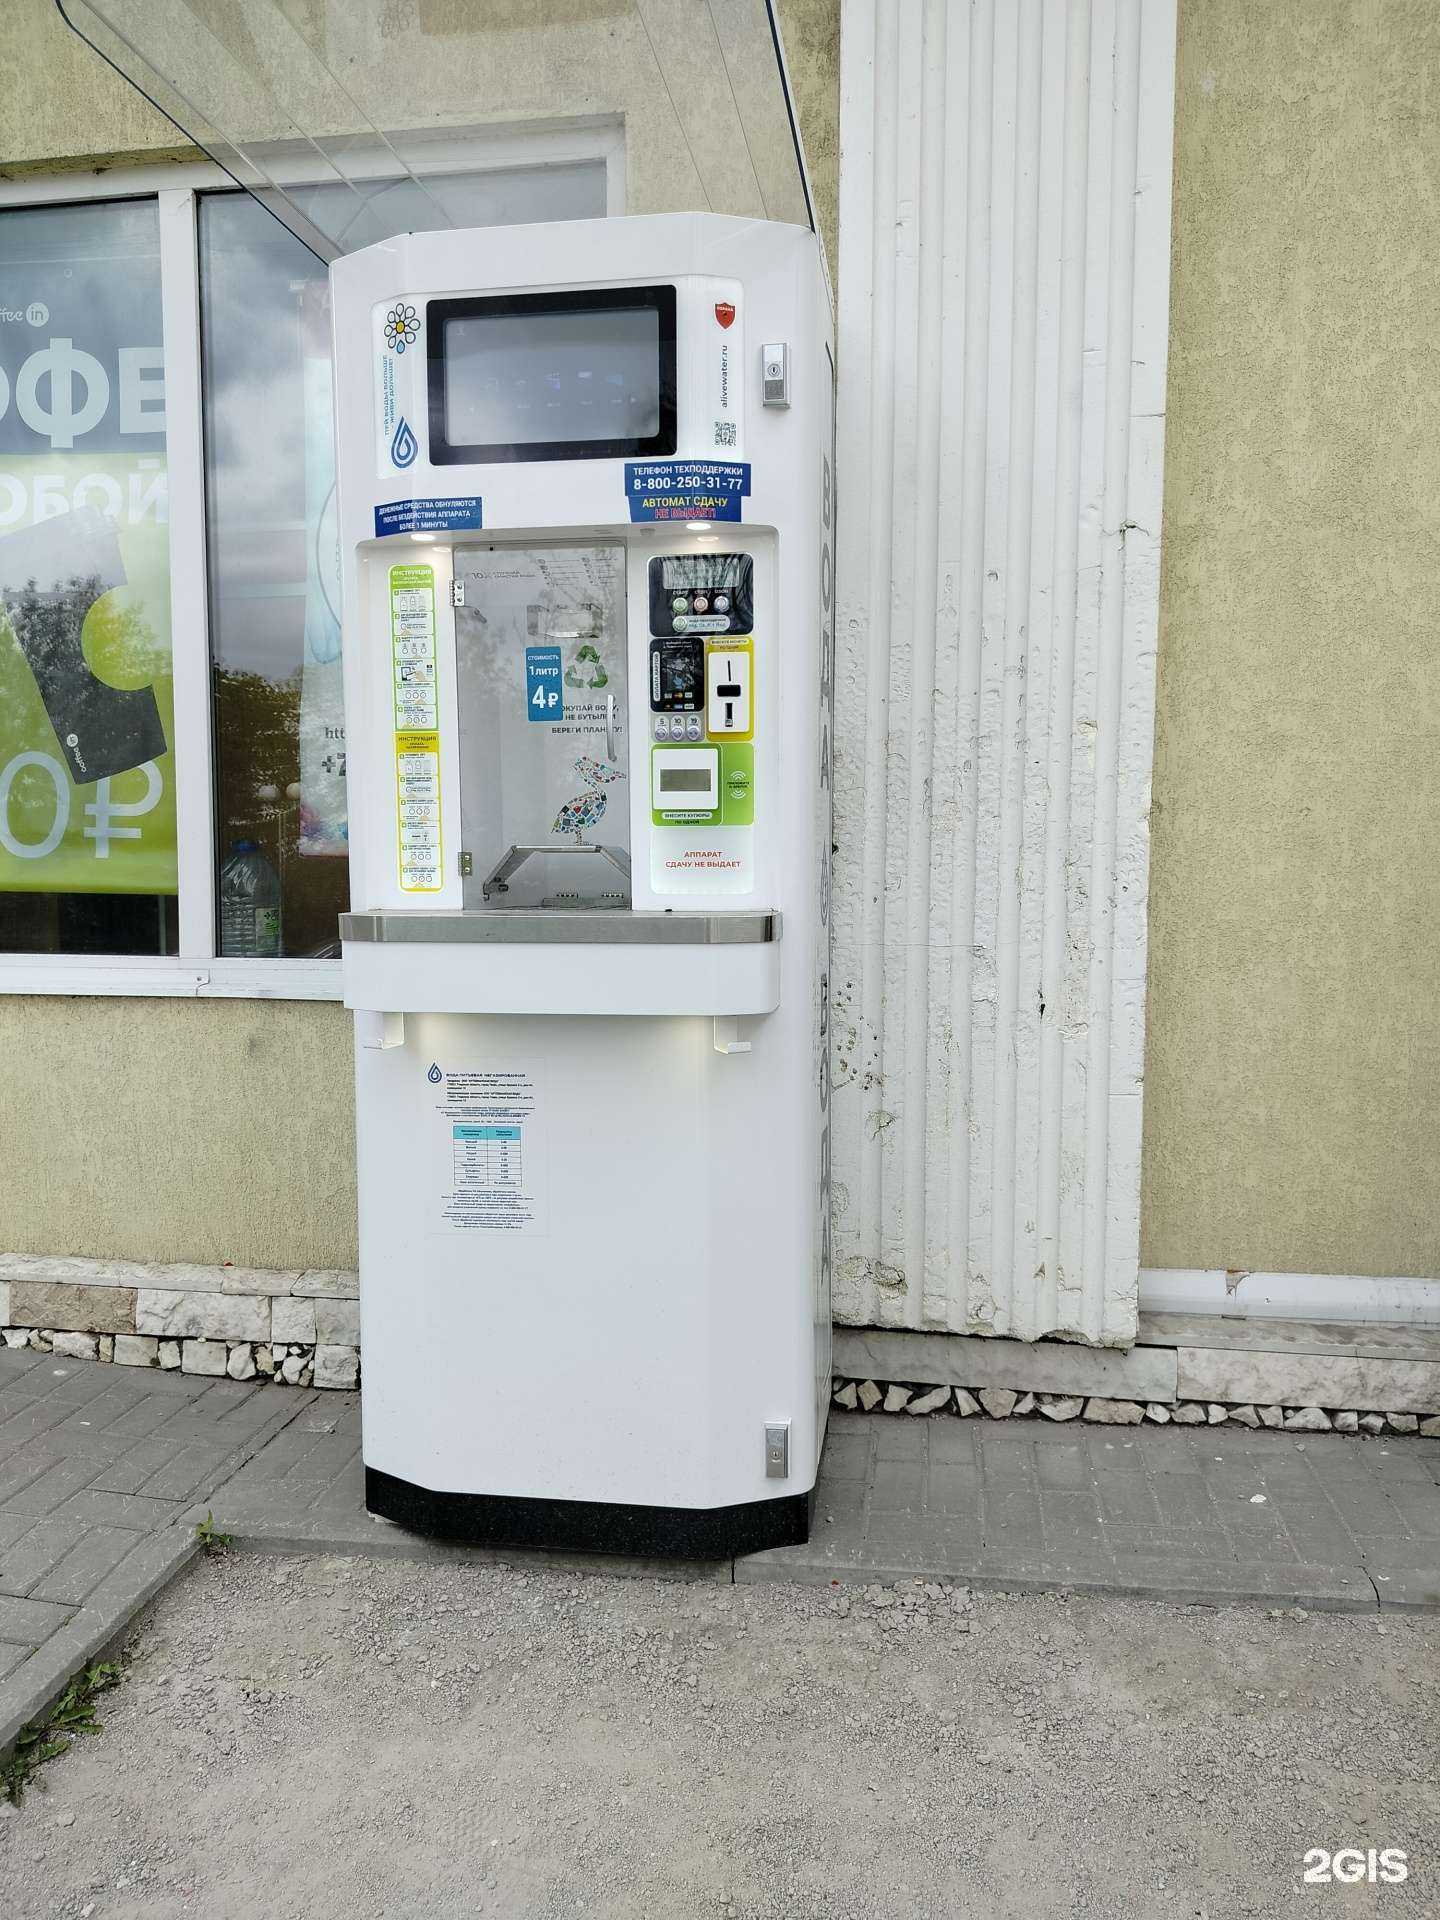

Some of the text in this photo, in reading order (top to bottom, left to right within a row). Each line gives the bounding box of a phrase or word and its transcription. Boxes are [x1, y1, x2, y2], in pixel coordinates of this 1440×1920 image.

[31, 306, 44, 321] in
[720, 345, 728, 408] alivewater.ru
[0, 338, 166, 448] ФЕ
[633, 464, 743, 476] ТЕЛЕФОН ТЕХПОДДЕРЖКИ
[633, 476, 743, 490] 8-800-250-31-77
[379, 500, 476, 514] ДЕНЕЖНЫЕ СРЕДСТВА ОБНУЛЯЮТСЯ
[642, 496, 729, 508] АВТОМАТ СДАЧУ
[383, 514, 399, 523] ПОСЛЕ
[438, 510, 471, 519] АППАРАТА
[655, 508, 669, 519] НЕ
[400, 522, 416, 530] БОЛЕЕ
[420, 521, 448, 529] МИНУТЫ
[595, 704, 619, 713] ВОУ,
[665, 861, 692, 869] СДАЧУ
[707, 861, 741, 869] ВЫДАЕТ
